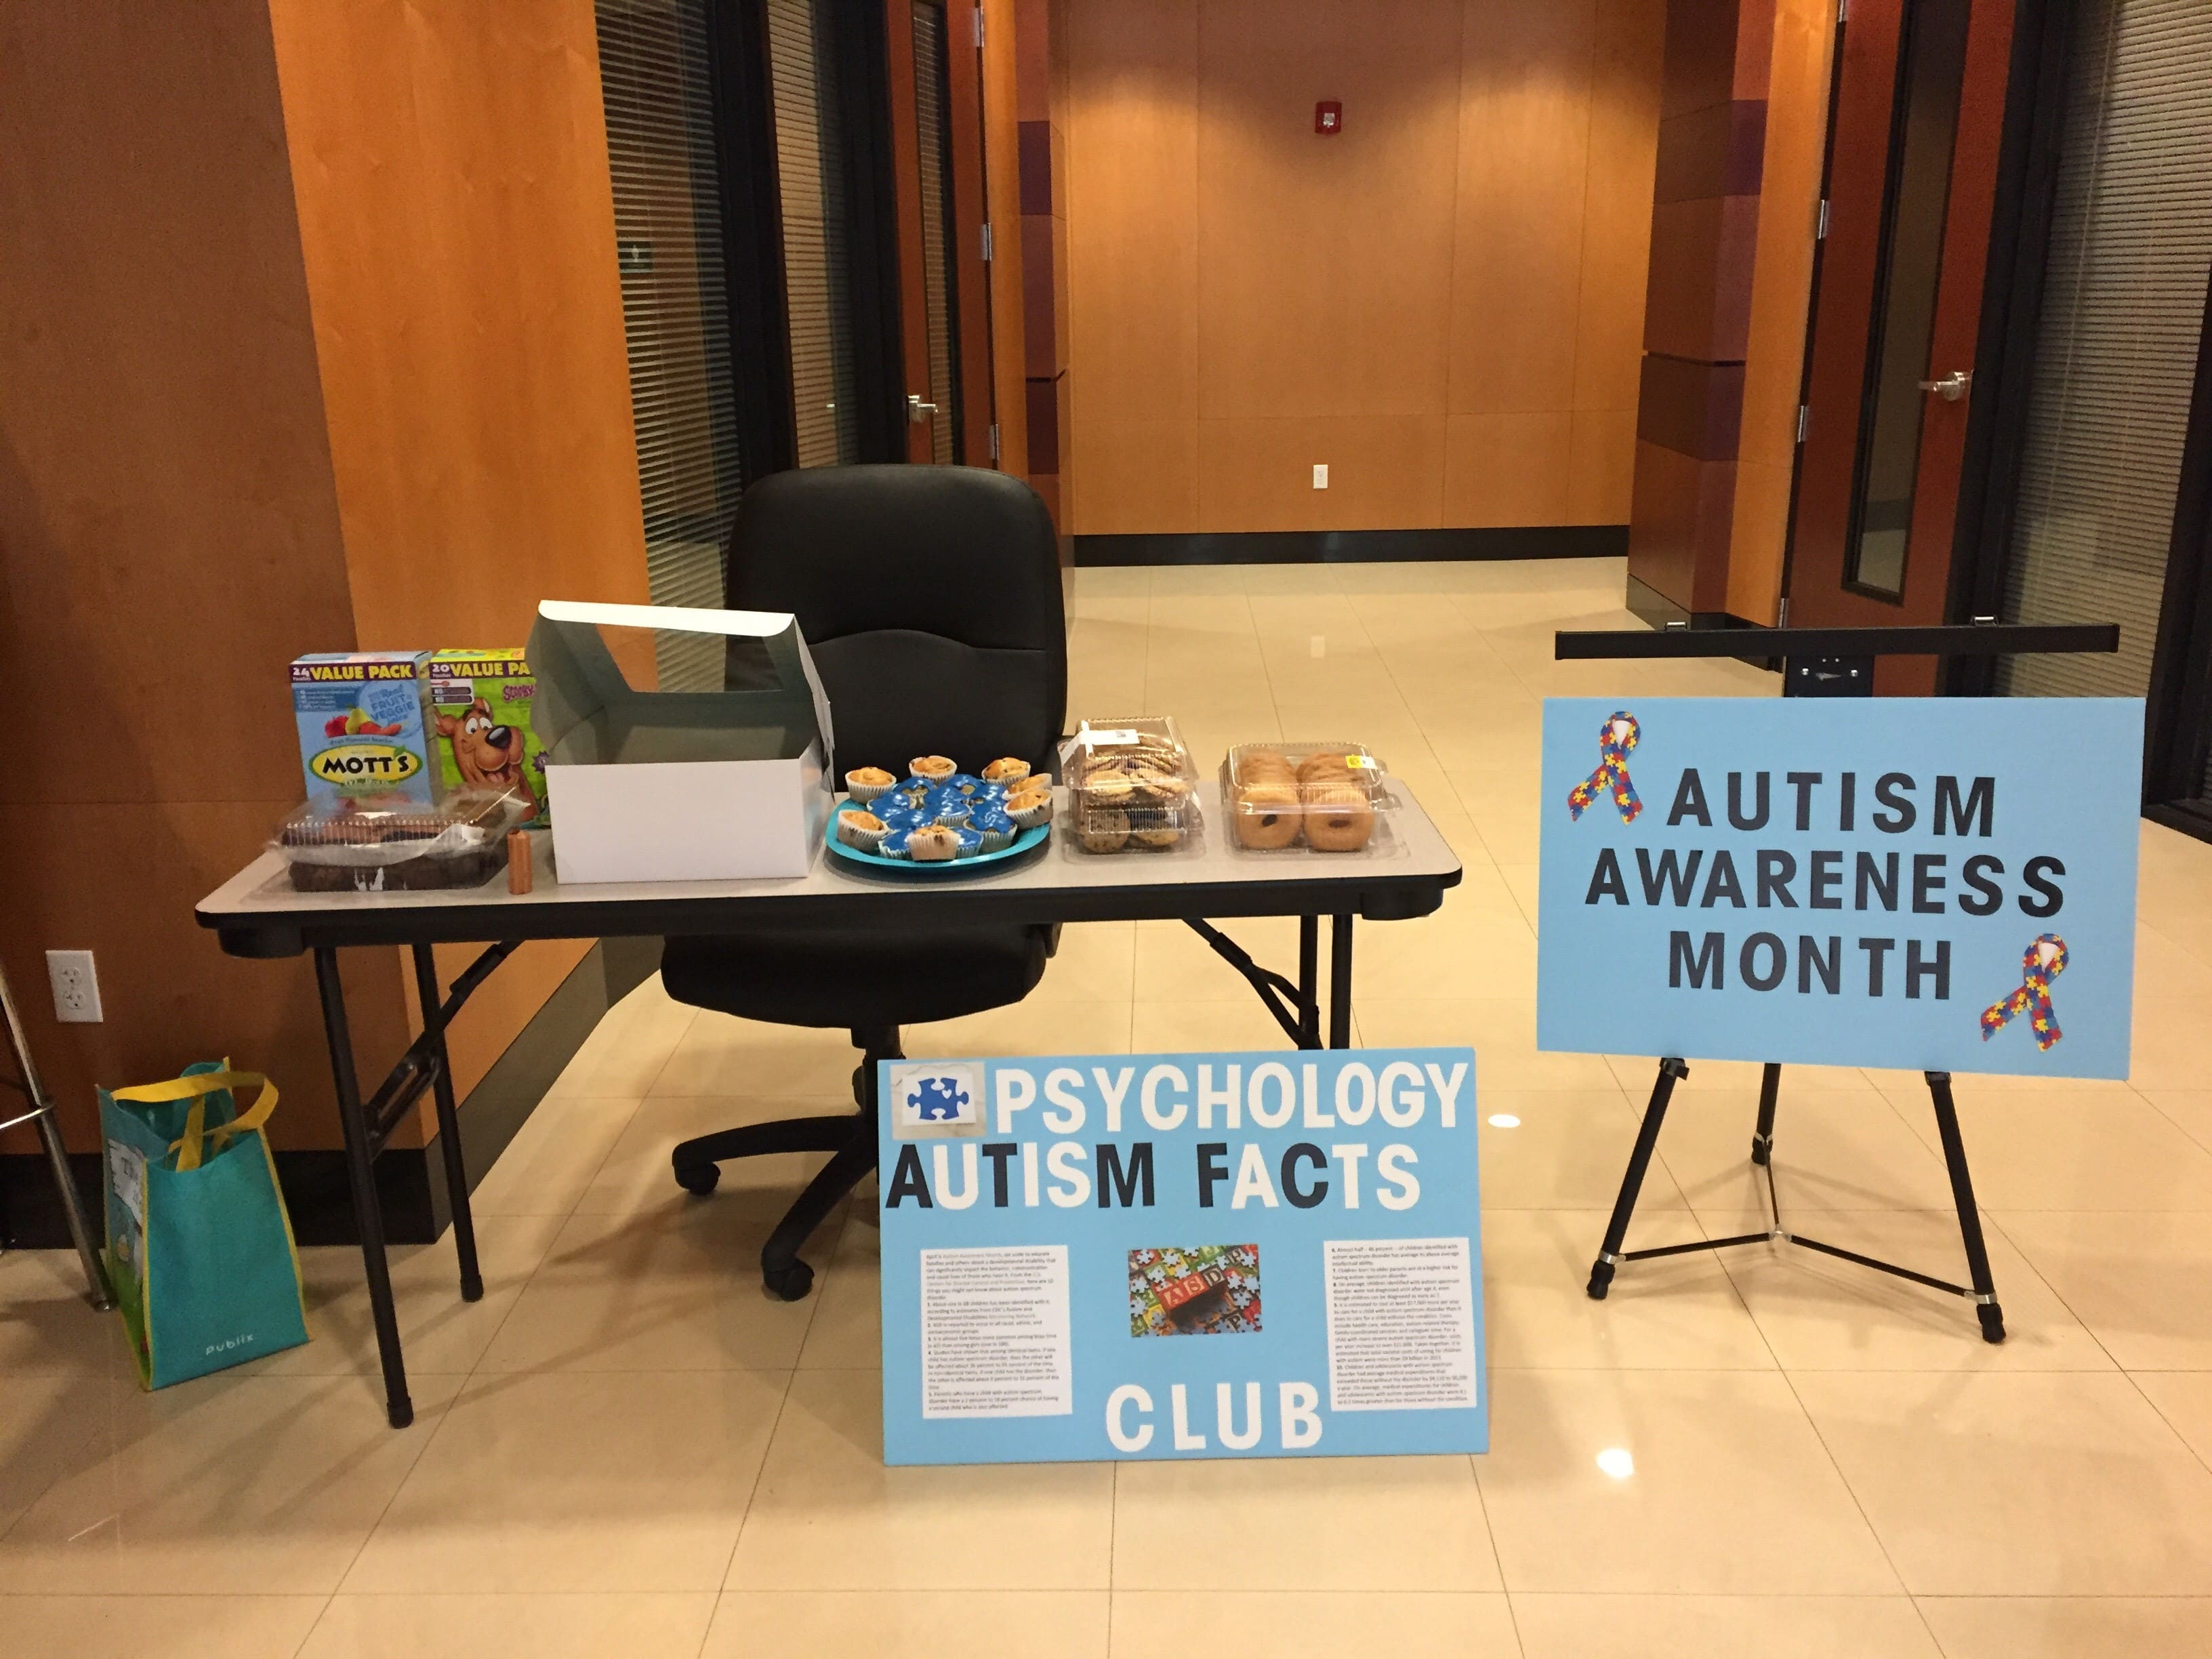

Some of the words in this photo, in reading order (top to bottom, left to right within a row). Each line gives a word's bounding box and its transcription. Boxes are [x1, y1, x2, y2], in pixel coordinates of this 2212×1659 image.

[293, 668, 310, 677] 24
[310, 665, 364, 680] VALUE
[368, 664, 413, 679] PACK
[432, 663, 450, 674] 20
[450, 662, 504, 676] VALUE
[508, 661, 531, 675] PA
[323, 756, 409, 774] MOTT'S
[1667, 768, 1995, 837] AUTISM
[1585, 848, 2066, 918] AWARENESS
[1668, 930, 1952, 1000] MONTH
[996, 1062, 1468, 1134] PSYCHOLOGY
[885, 1142, 1155, 1209] AUTISM
[1197, 1142, 1420, 1210] FACTS
[1162, 1267, 1226, 1308] ASD
[1105, 1381, 1324, 1453] CLUB
